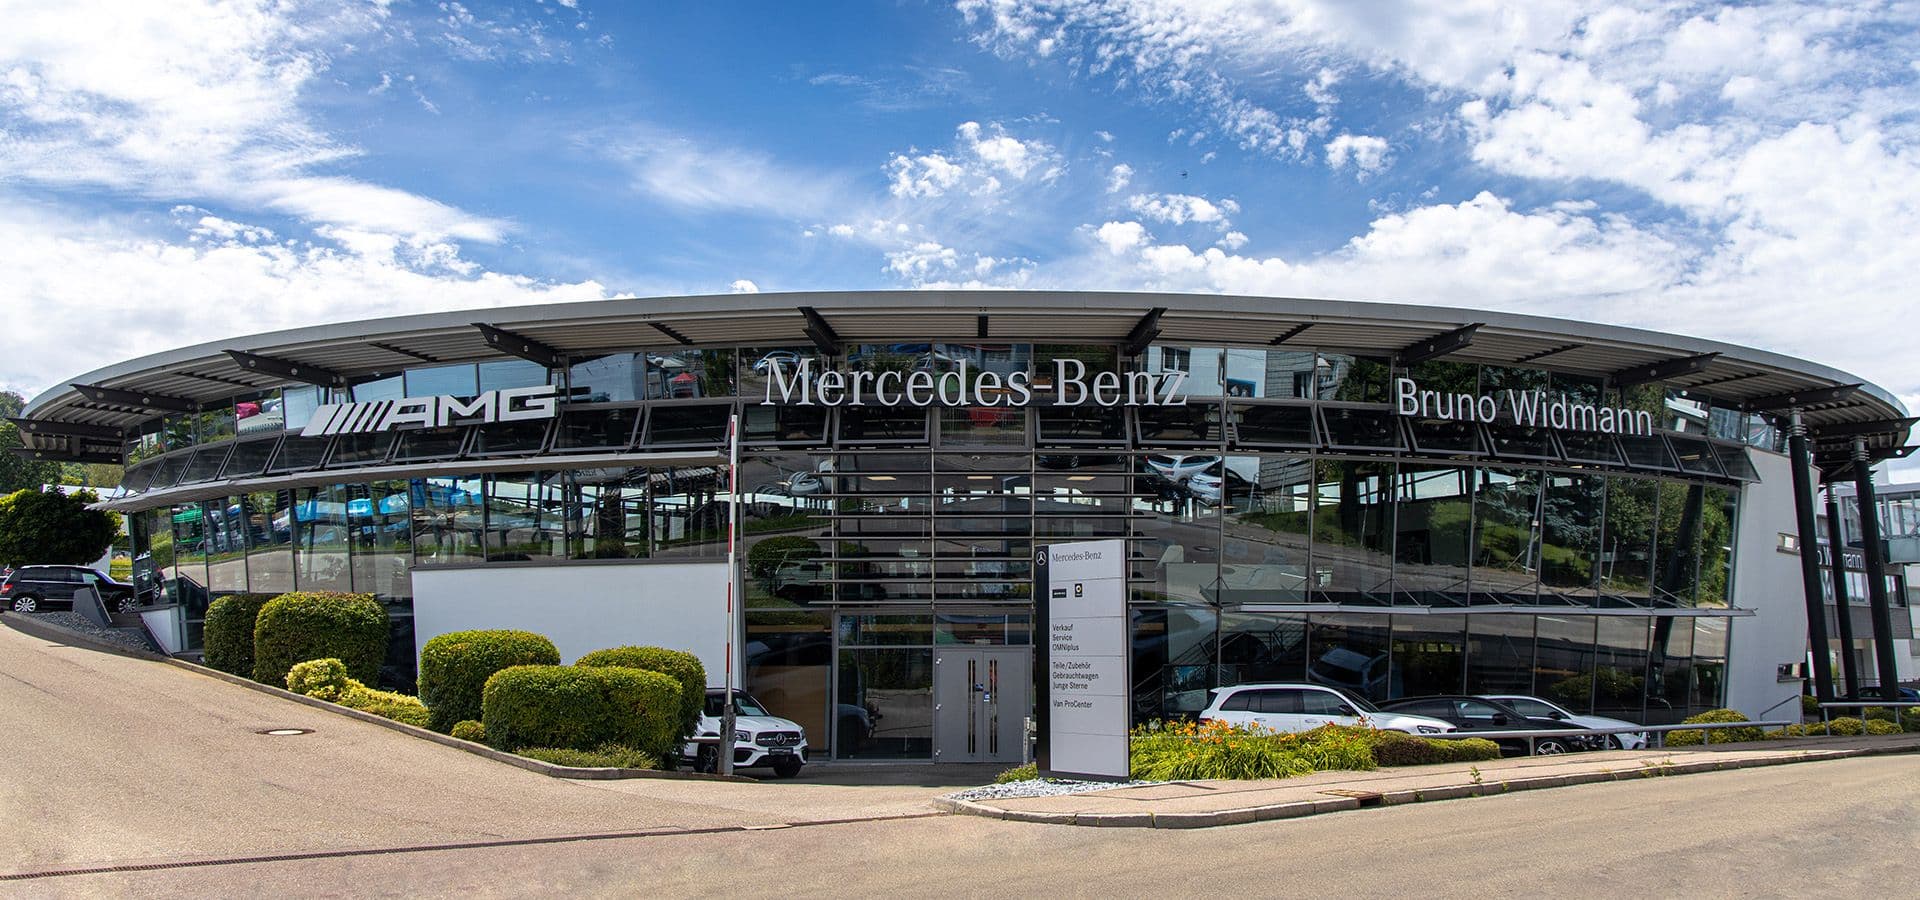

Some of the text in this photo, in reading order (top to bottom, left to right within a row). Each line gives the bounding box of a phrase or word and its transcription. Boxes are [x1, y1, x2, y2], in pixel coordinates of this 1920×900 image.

[760, 357, 1189, 407] Mercedes-Benz
[1395, 377, 1652, 436] Bruno Widmann
[1052, 551, 1102, 562] Mercedes-Benz
[1052, 671, 1099, 681] Gebrauchtwagen
[1052, 681, 1089, 690] Junge Sterne
[1053, 700, 1093, 709] Van ProCenter
